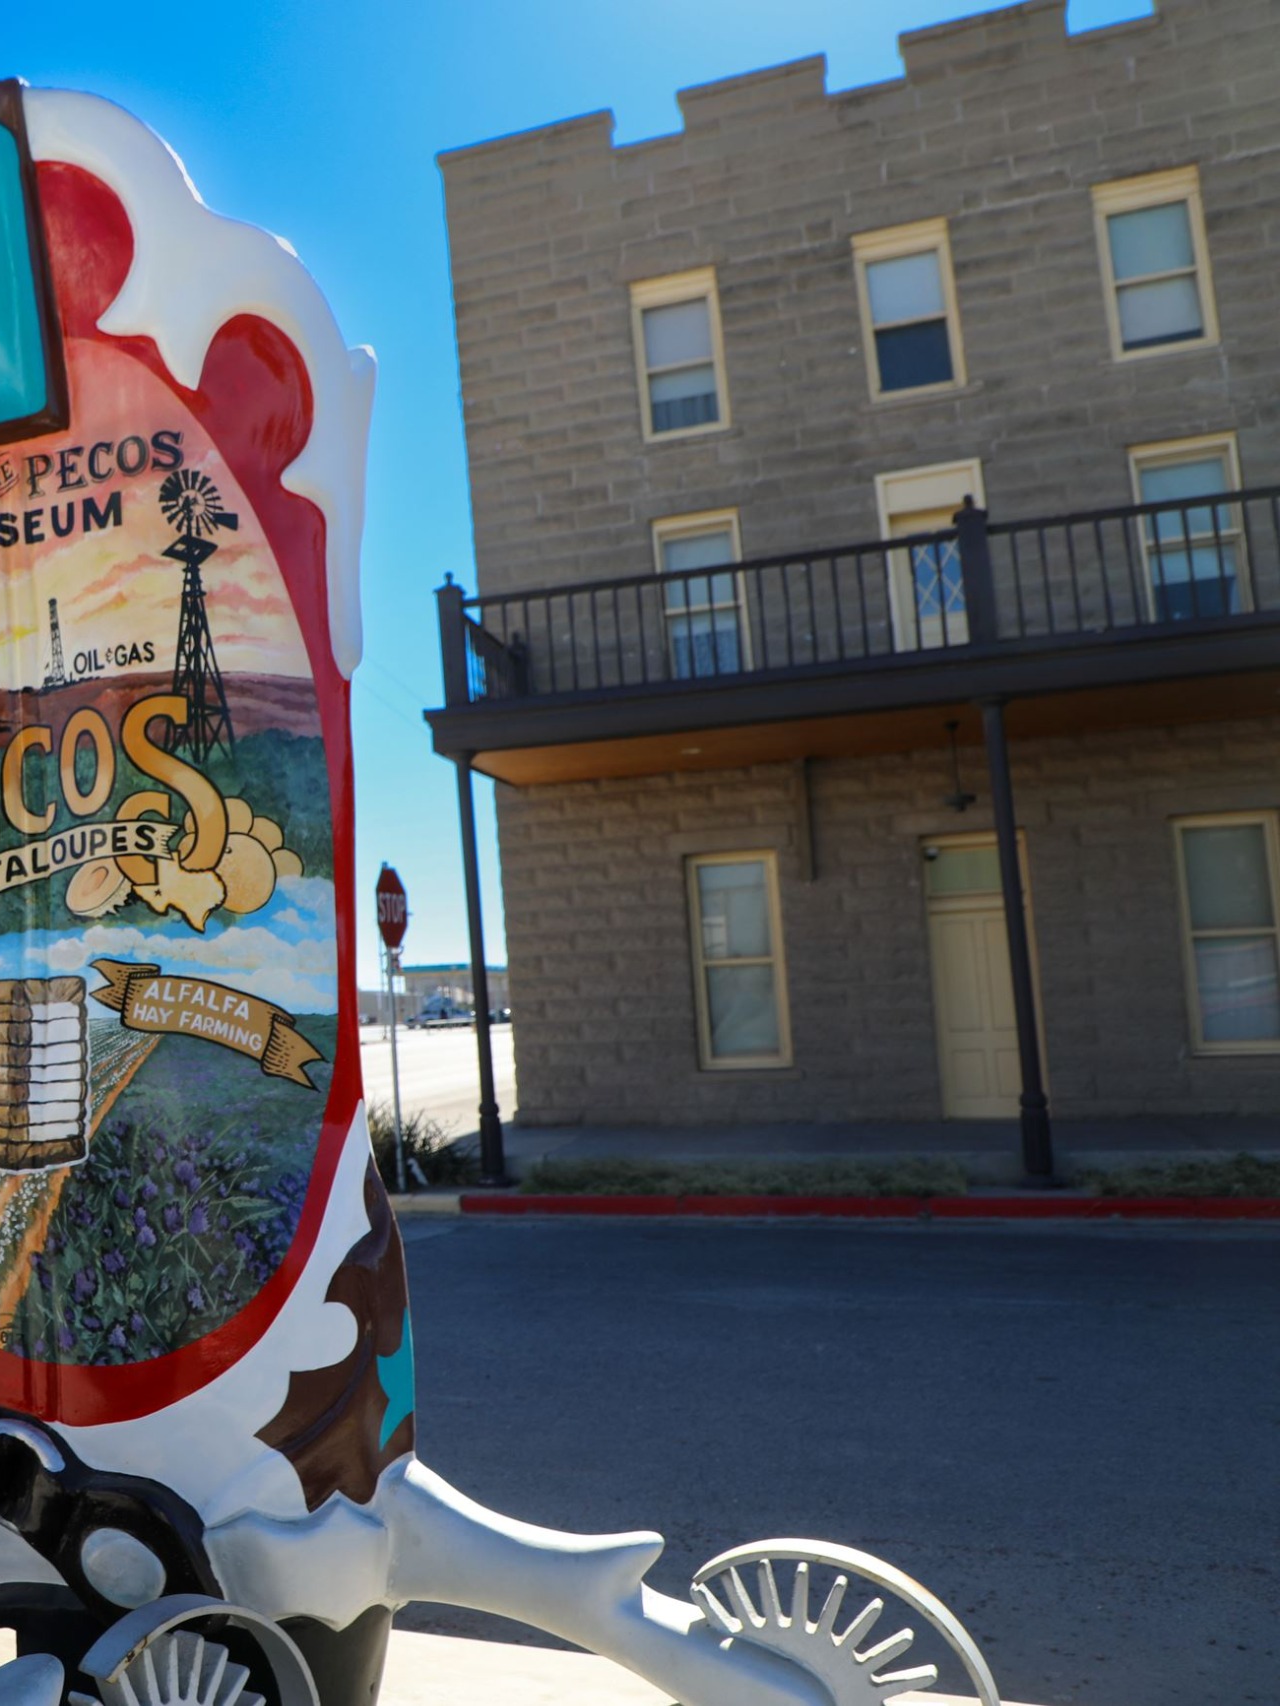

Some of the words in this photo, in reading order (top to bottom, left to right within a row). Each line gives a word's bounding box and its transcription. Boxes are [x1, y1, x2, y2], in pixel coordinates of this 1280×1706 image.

[24, 430, 185, 499] PECOS
[73, 648, 105, 675] OIL
[115, 641, 156, 666] GAS
[378, 892, 405, 924] STOP
[144, 980, 249, 1020] ALFALFA
[132, 1002, 174, 1024] HAY
[179, 1010, 263, 1052] FARMING
